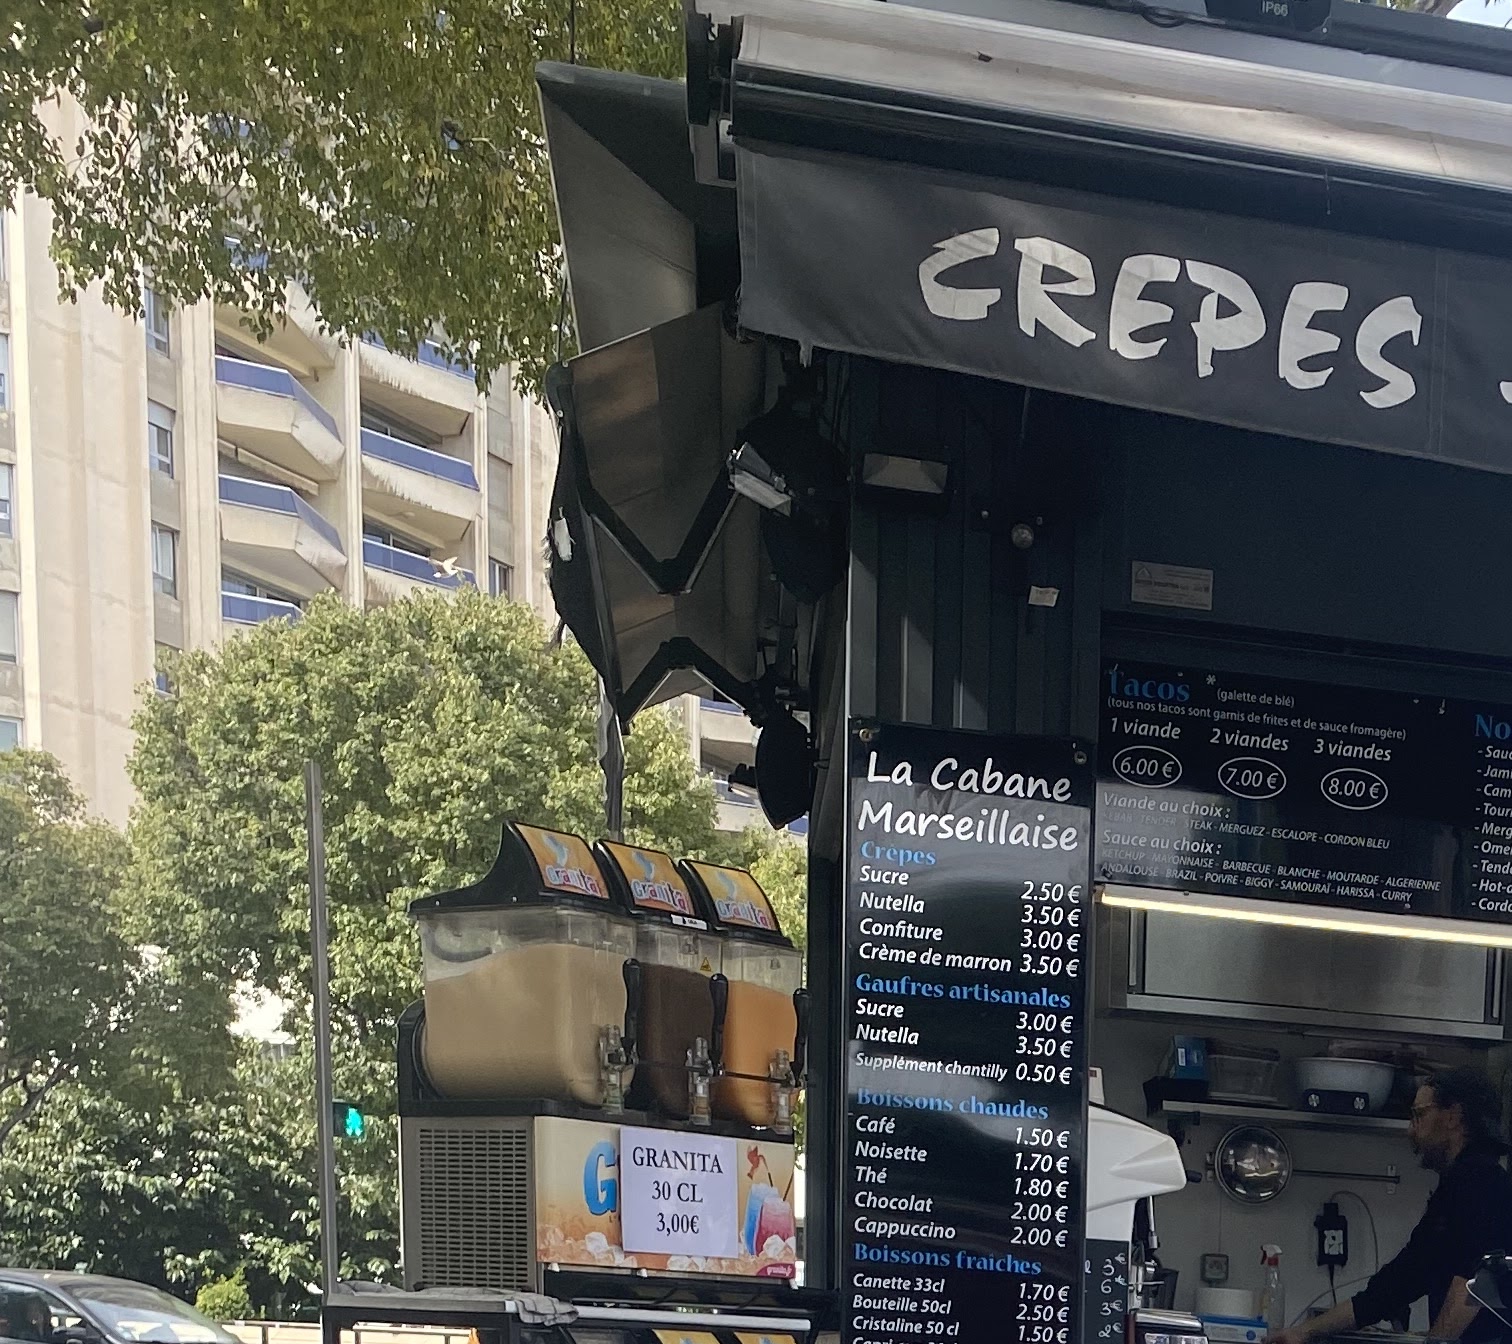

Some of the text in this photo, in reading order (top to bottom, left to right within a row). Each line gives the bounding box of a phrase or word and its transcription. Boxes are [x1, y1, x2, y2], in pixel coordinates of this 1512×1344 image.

[917, 226, 1423, 409] CREPES
[1110, 718, 1182, 739] 1 viande
[1210, 728, 1289, 751] 2 viandes
[867, 752, 1072, 802] La Cabane
[1120, 757, 1159, 776] 6.00
[857, 800, 1079, 851] Marseillaise
[1219, 823, 1265, 837] MERGUEZ
[859, 866, 909, 886] Sucre
[632, 879, 686, 911] Granita
[859, 892, 925, 914] Nutella
[1021, 881, 1064, 902] 2.50
[1381, 890, 1412, 902] CURRY
[716, 900, 769, 927] Granita
[1021, 905, 1063, 926] 3.50
[859, 943, 1012, 972] Crème de marron
[856, 973, 1071, 1009] Gaufres artisanales
[855, 1053, 1008, 1082] Supplément chantilly
[1016, 1063, 1056, 1083] 0.50
[856, 1088, 1049, 1120] Boissons chaudes
[855, 1115, 896, 1134] Café
[1015, 1128, 1054, 1147] 1.50
[632, 1146, 723, 1174] GRANITA
[855, 1141, 928, 1162] Noisette
[652, 1181, 703, 1203] 30 CL
[657, 1213, 700, 1236] 3,00€
[854, 1217, 956, 1241] Cappuccino
[854, 1243, 950, 1267] Boissons
